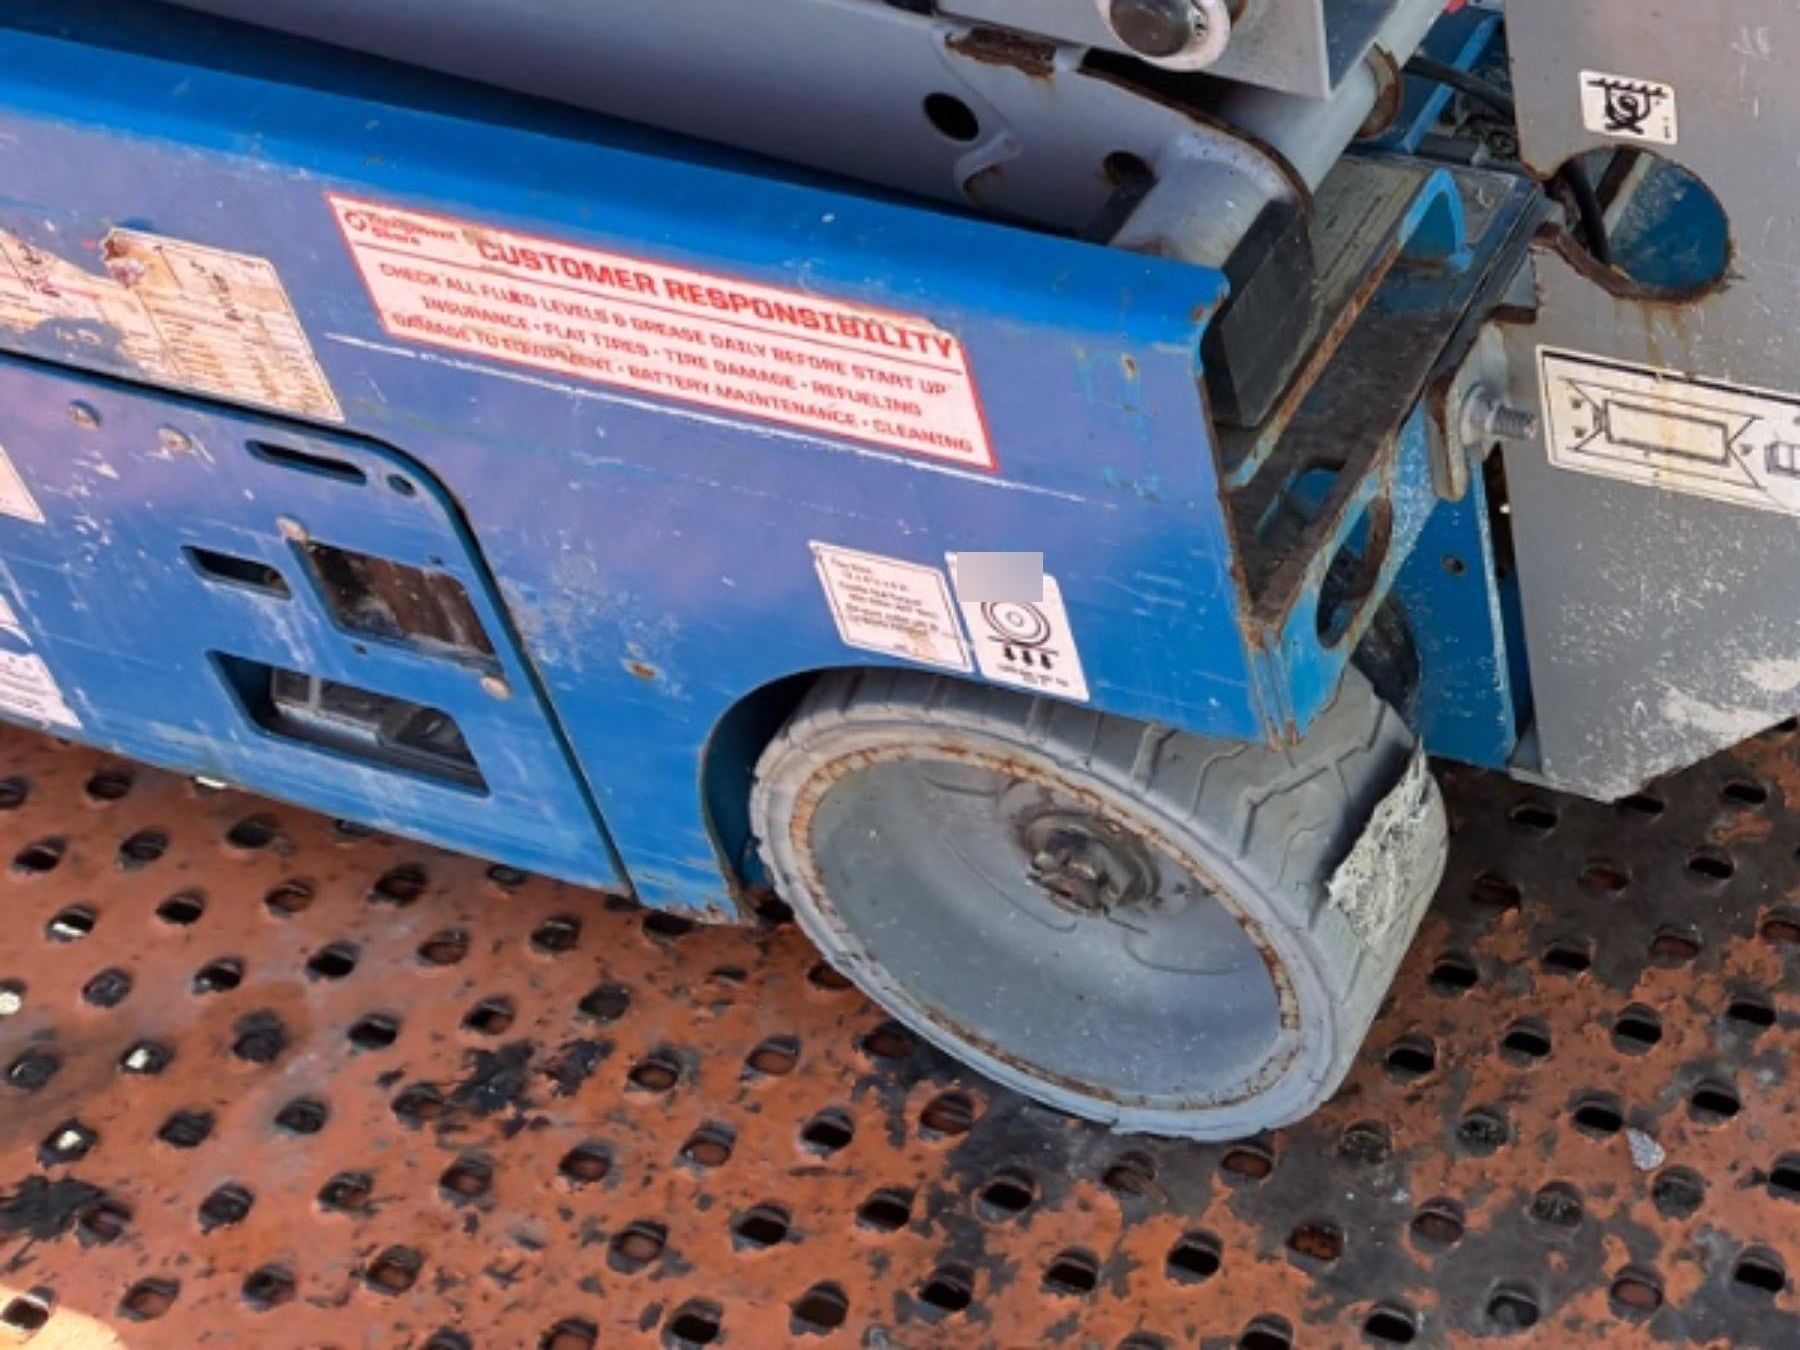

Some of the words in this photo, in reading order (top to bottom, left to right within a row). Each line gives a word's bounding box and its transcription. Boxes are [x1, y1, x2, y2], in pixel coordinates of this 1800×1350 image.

[476, 239, 658, 296] CUSTOMER
[663, 277, 953, 358] RESPONSIBILITY
[771, 343, 848, 376] BEFORE
